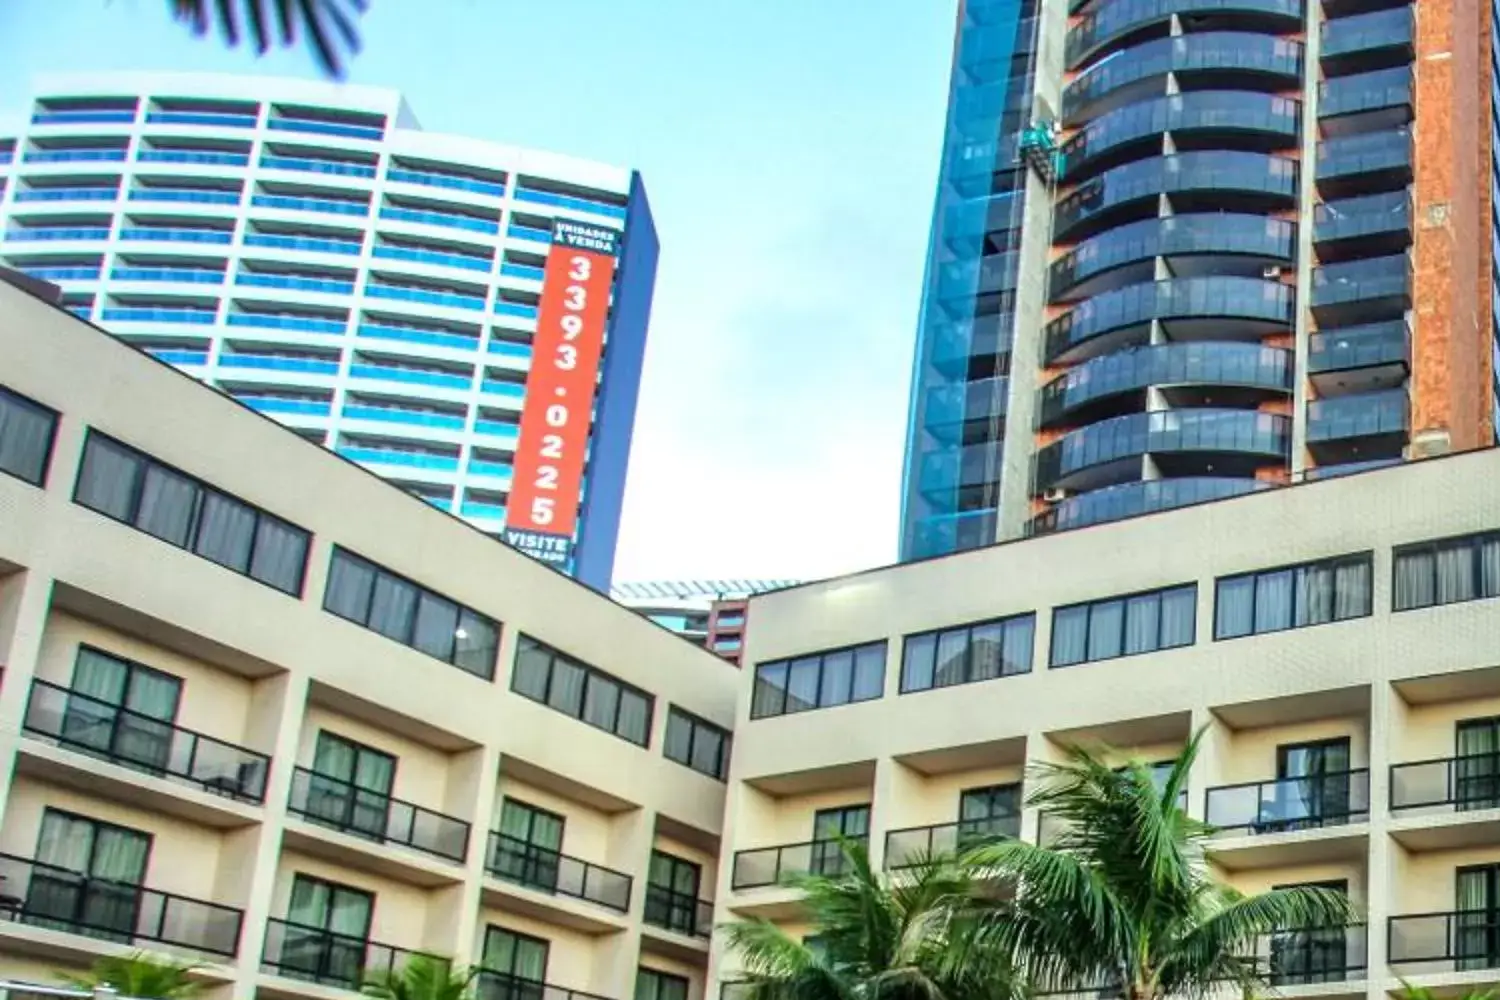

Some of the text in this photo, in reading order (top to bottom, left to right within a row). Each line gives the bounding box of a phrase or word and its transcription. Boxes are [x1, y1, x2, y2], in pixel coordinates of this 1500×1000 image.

[557, 223, 614, 241] UNIDADES
[567, 234, 613, 252] VENDA
[508, 532, 567, 551] VISITE
